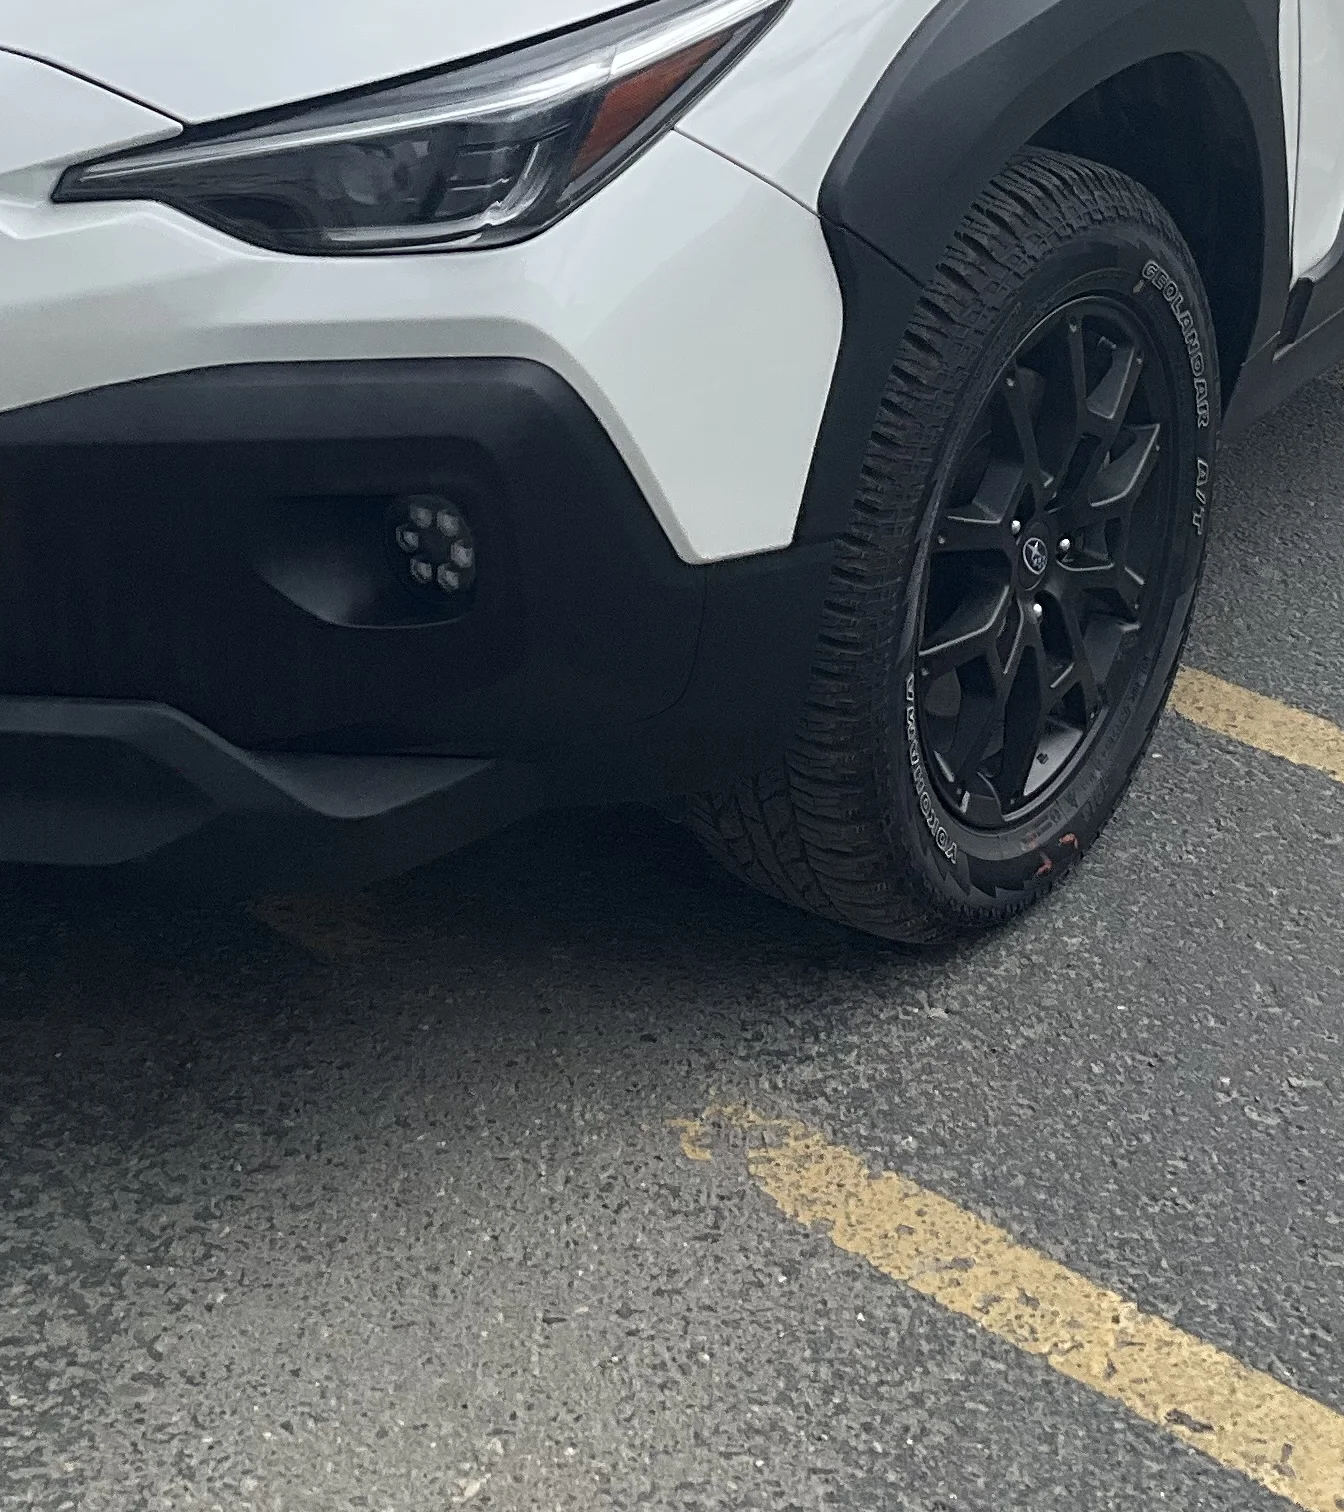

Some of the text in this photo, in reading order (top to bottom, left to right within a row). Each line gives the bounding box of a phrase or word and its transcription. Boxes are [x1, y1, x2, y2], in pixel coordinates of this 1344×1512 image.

[1141, 259, 1210, 536] GEOLANDAR A/T
[906, 671, 958, 865] YOKOHAMA
